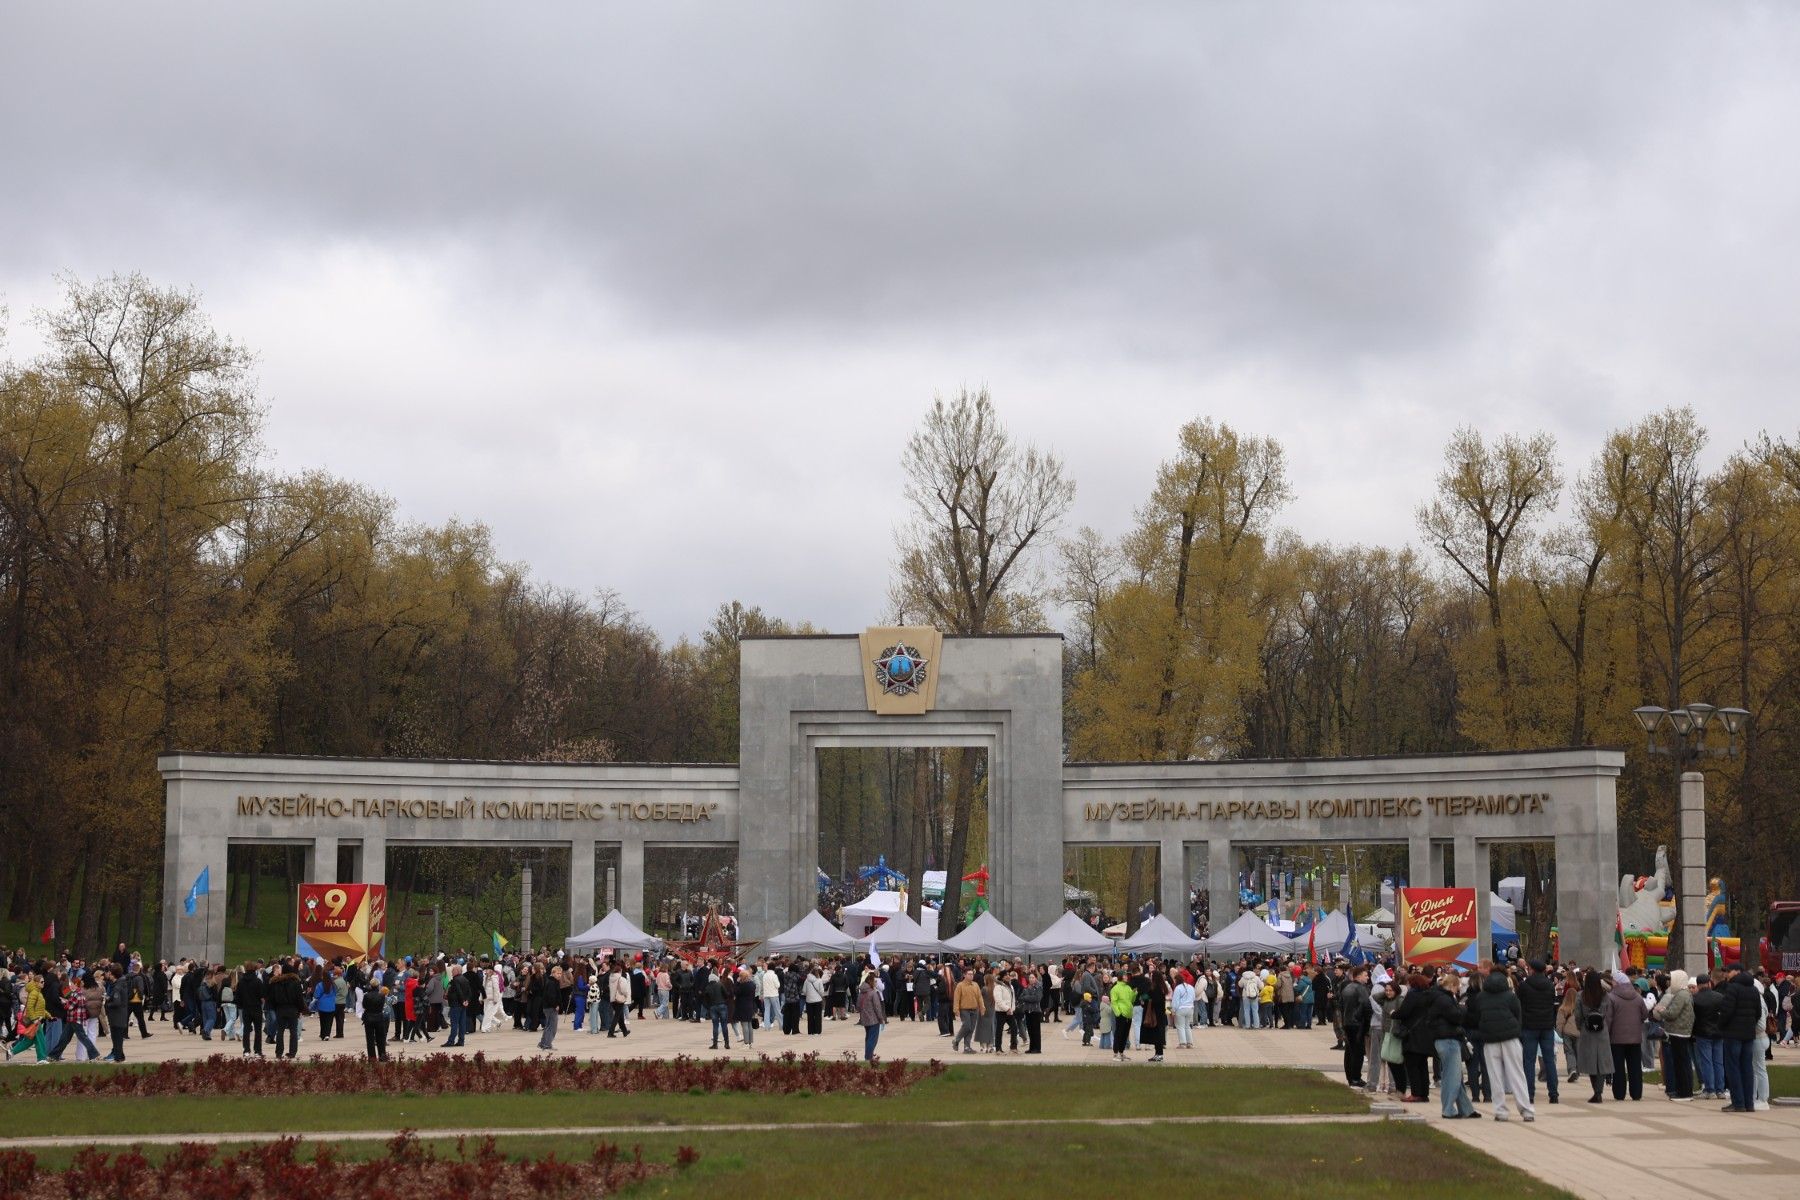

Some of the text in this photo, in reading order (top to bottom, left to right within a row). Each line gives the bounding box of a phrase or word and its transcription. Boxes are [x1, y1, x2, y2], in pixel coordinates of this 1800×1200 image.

[237, 794, 475, 819] МУЗЕЙНО-ПАРКОВЫЙ
[483, 800, 604, 821] КОМПЛЕКС
[1085, 798, 1300, 821] МУЗЕЙНА-ПАРКАВЫ
[1307, 797, 1422, 819] КОМПЛЕКС
[324, 889, 347, 917] 9
[1408, 896, 1454, 918] С Днем
[324, 919, 346, 927] МАЯ
[1411, 900, 1474, 936] Победы!
